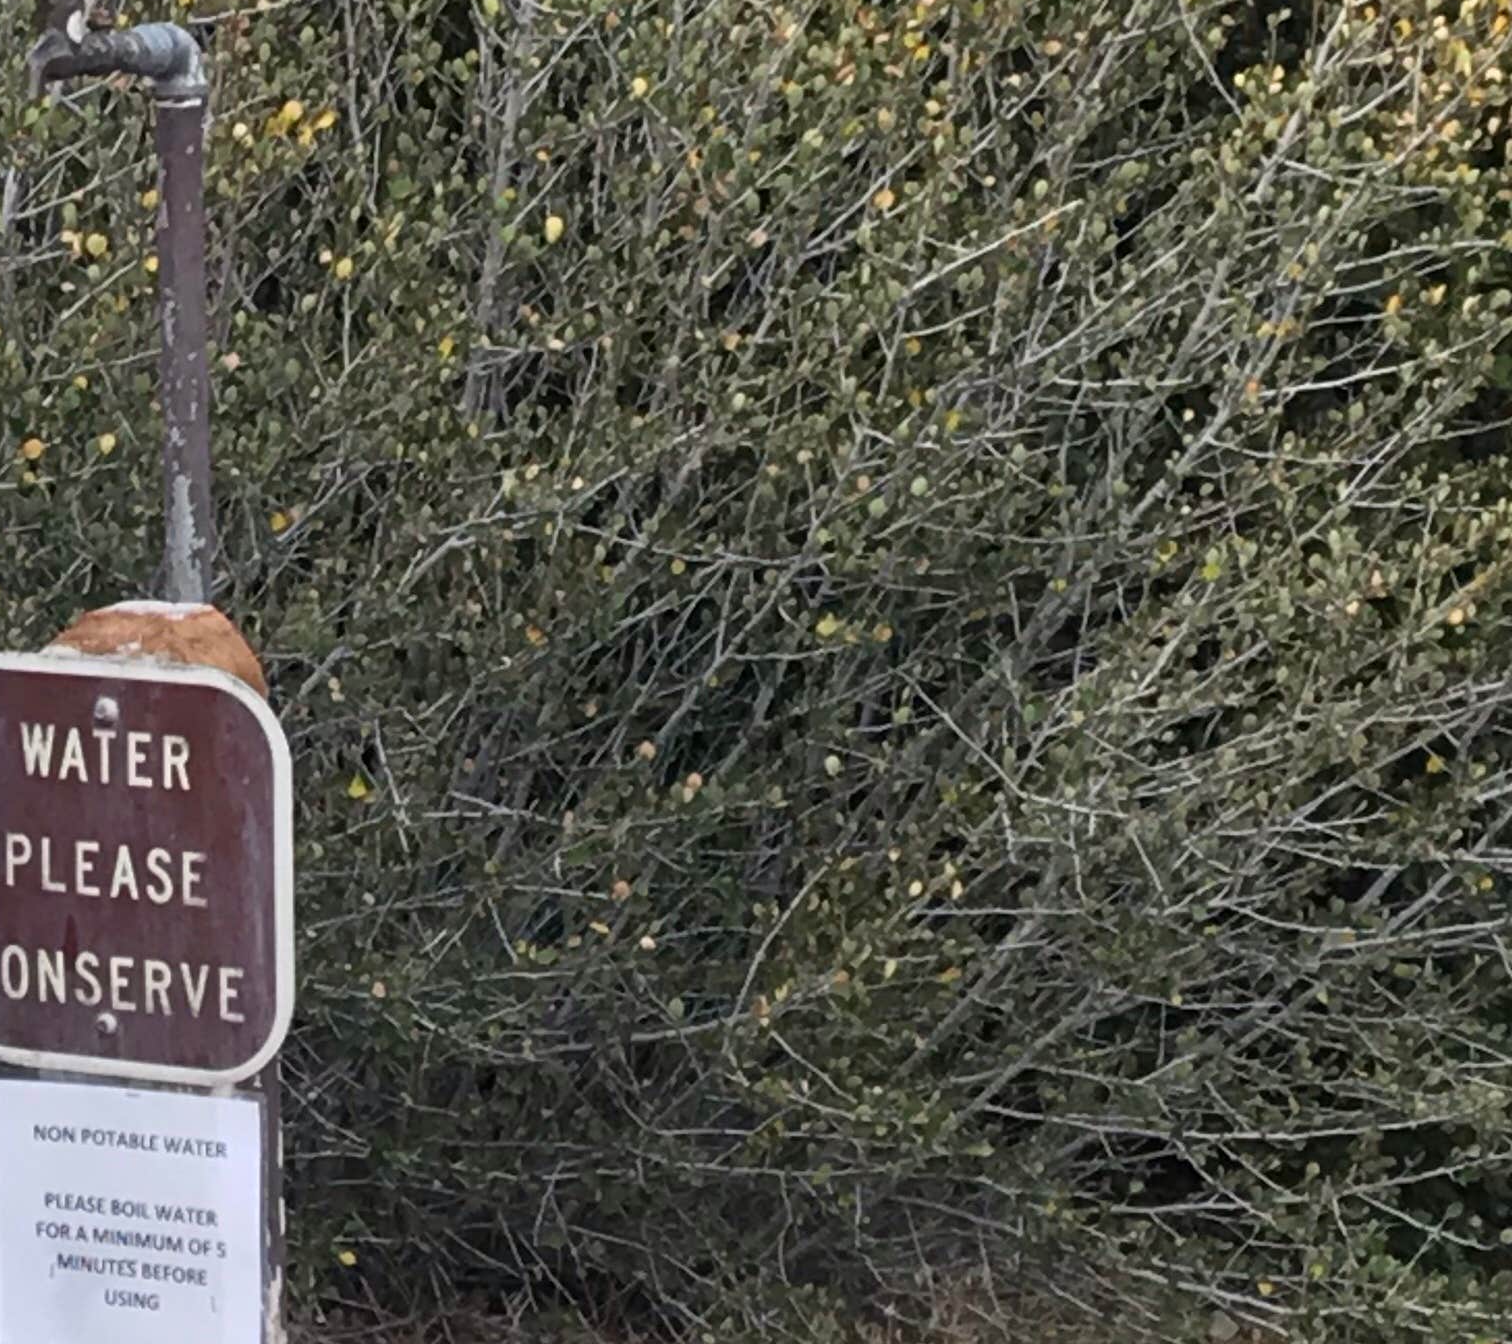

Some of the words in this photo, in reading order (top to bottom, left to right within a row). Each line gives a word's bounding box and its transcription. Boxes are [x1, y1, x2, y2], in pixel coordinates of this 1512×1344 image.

[20, 721, 191, 791] WATER
[5, 832, 208, 907] PLEASE
[33, 1125, 76, 1144] NON
[80, 1129, 158, 1153] POTABLE
[163, 1136, 227, 1158] WATER
[44, 1192, 106, 1215] PLEASE
[110, 1199, 150, 1221] BOIL
[154, 1204, 218, 1227] WATER
[35, 1221, 71, 1241] FOR
[75, 1226, 89, 1242] A
[92, 1229, 183, 1254] MINIMUM
[188, 1239, 213, 1256] OF
[56, 1253, 138, 1279] MINUTES
[141, 1262, 208, 1286] BEFORE
[104, 1289, 160, 1311] USING
